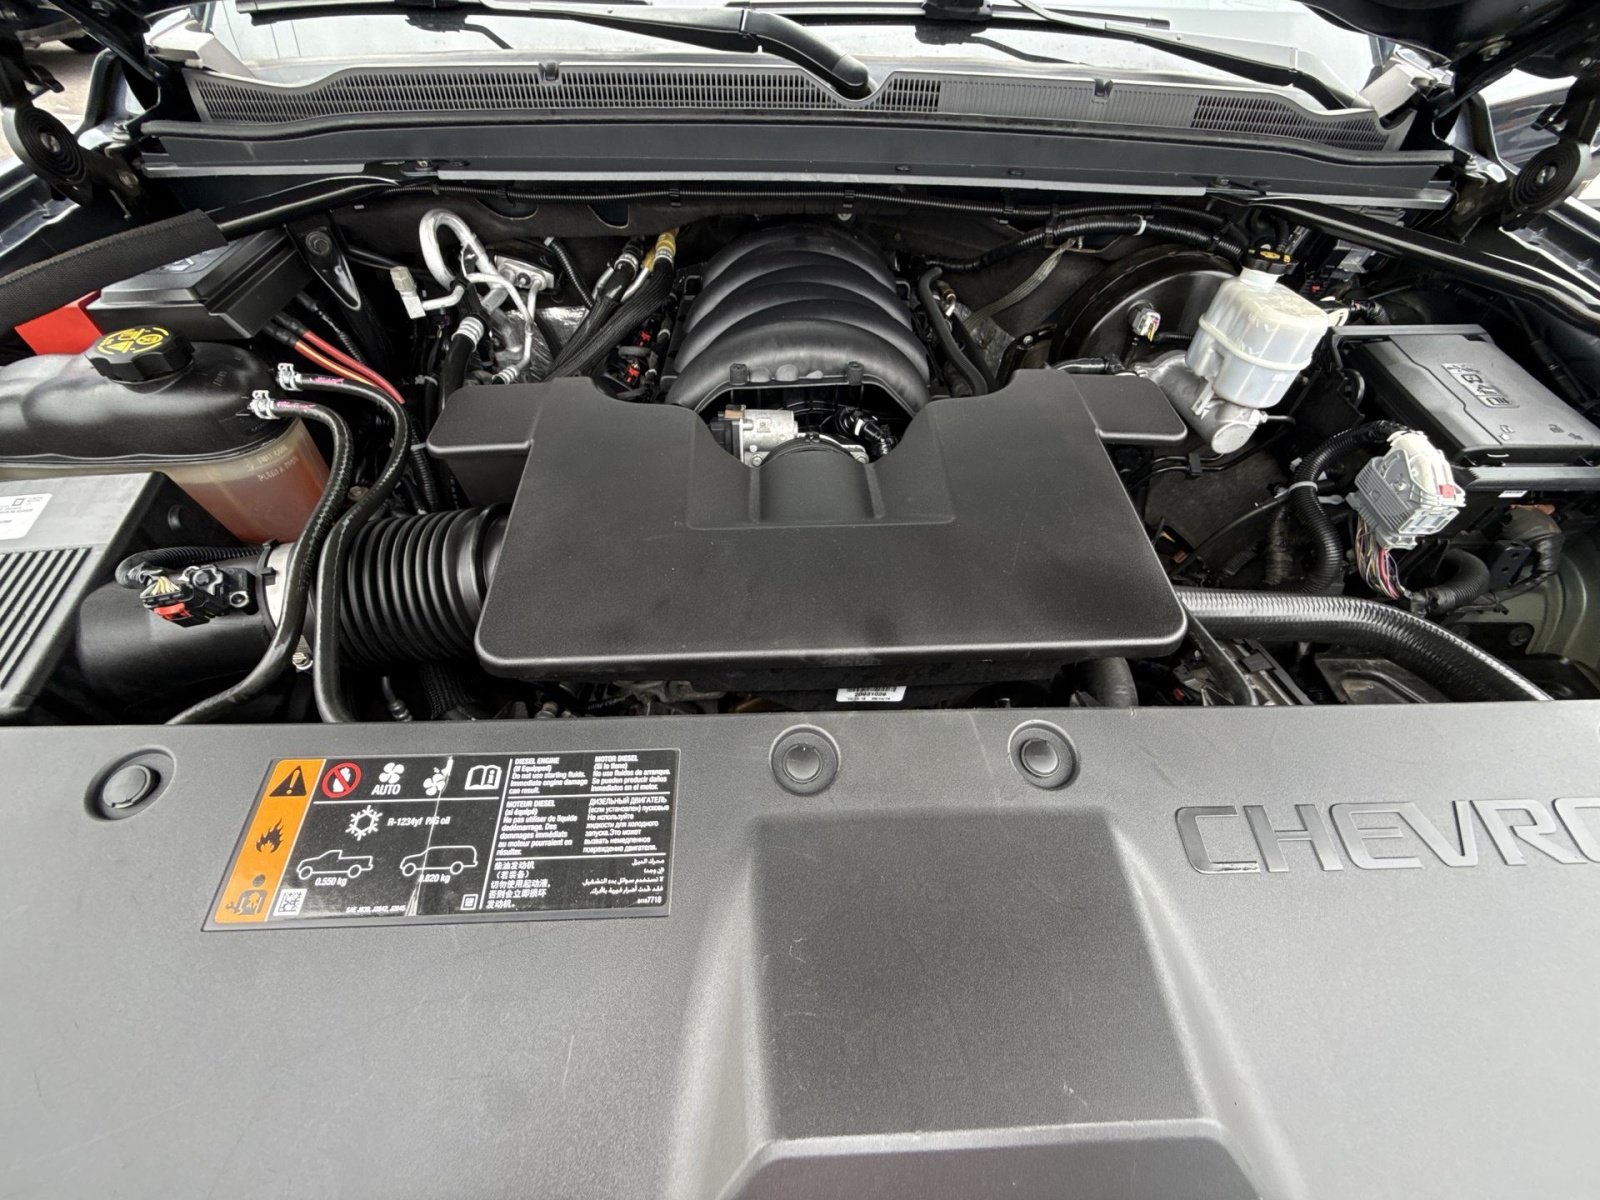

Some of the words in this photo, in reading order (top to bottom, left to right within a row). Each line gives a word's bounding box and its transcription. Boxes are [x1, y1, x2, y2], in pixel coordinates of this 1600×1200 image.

[544, 771, 567, 779] starting
[542, 779, 563, 787] engine
[601, 777, 623, 785] pueden
[623, 776, 648, 784] producir
[371, 784, 401, 795] AUTO
[506, 800, 533, 808] MOTEUR
[589, 796, 629, 806] ДИЗЕЛЬНЫЙ
[630, 796, 667, 805] ДВИГАТЕЛЬ
[588, 806, 605, 815] (если
[642, 805, 670, 813] пусковые
[387, 817, 423, 827] R-1234yf
[440, 816, 451, 825] oil
[557, 815, 578, 823] liquide
[597, 813, 634, 821] используйте
[500, 832, 534, 840] dommages
[530, 839, 563, 848] pourraient
[583, 846, 624, 854] повреждение
[494, 861, 535, 870] 柴油发动机
[315, 877, 336, 886] 0.550
[336, 877, 347, 887] kg
[440, 874, 451, 884] kg
[489, 889, 547, 899] 否则会立即损坏
